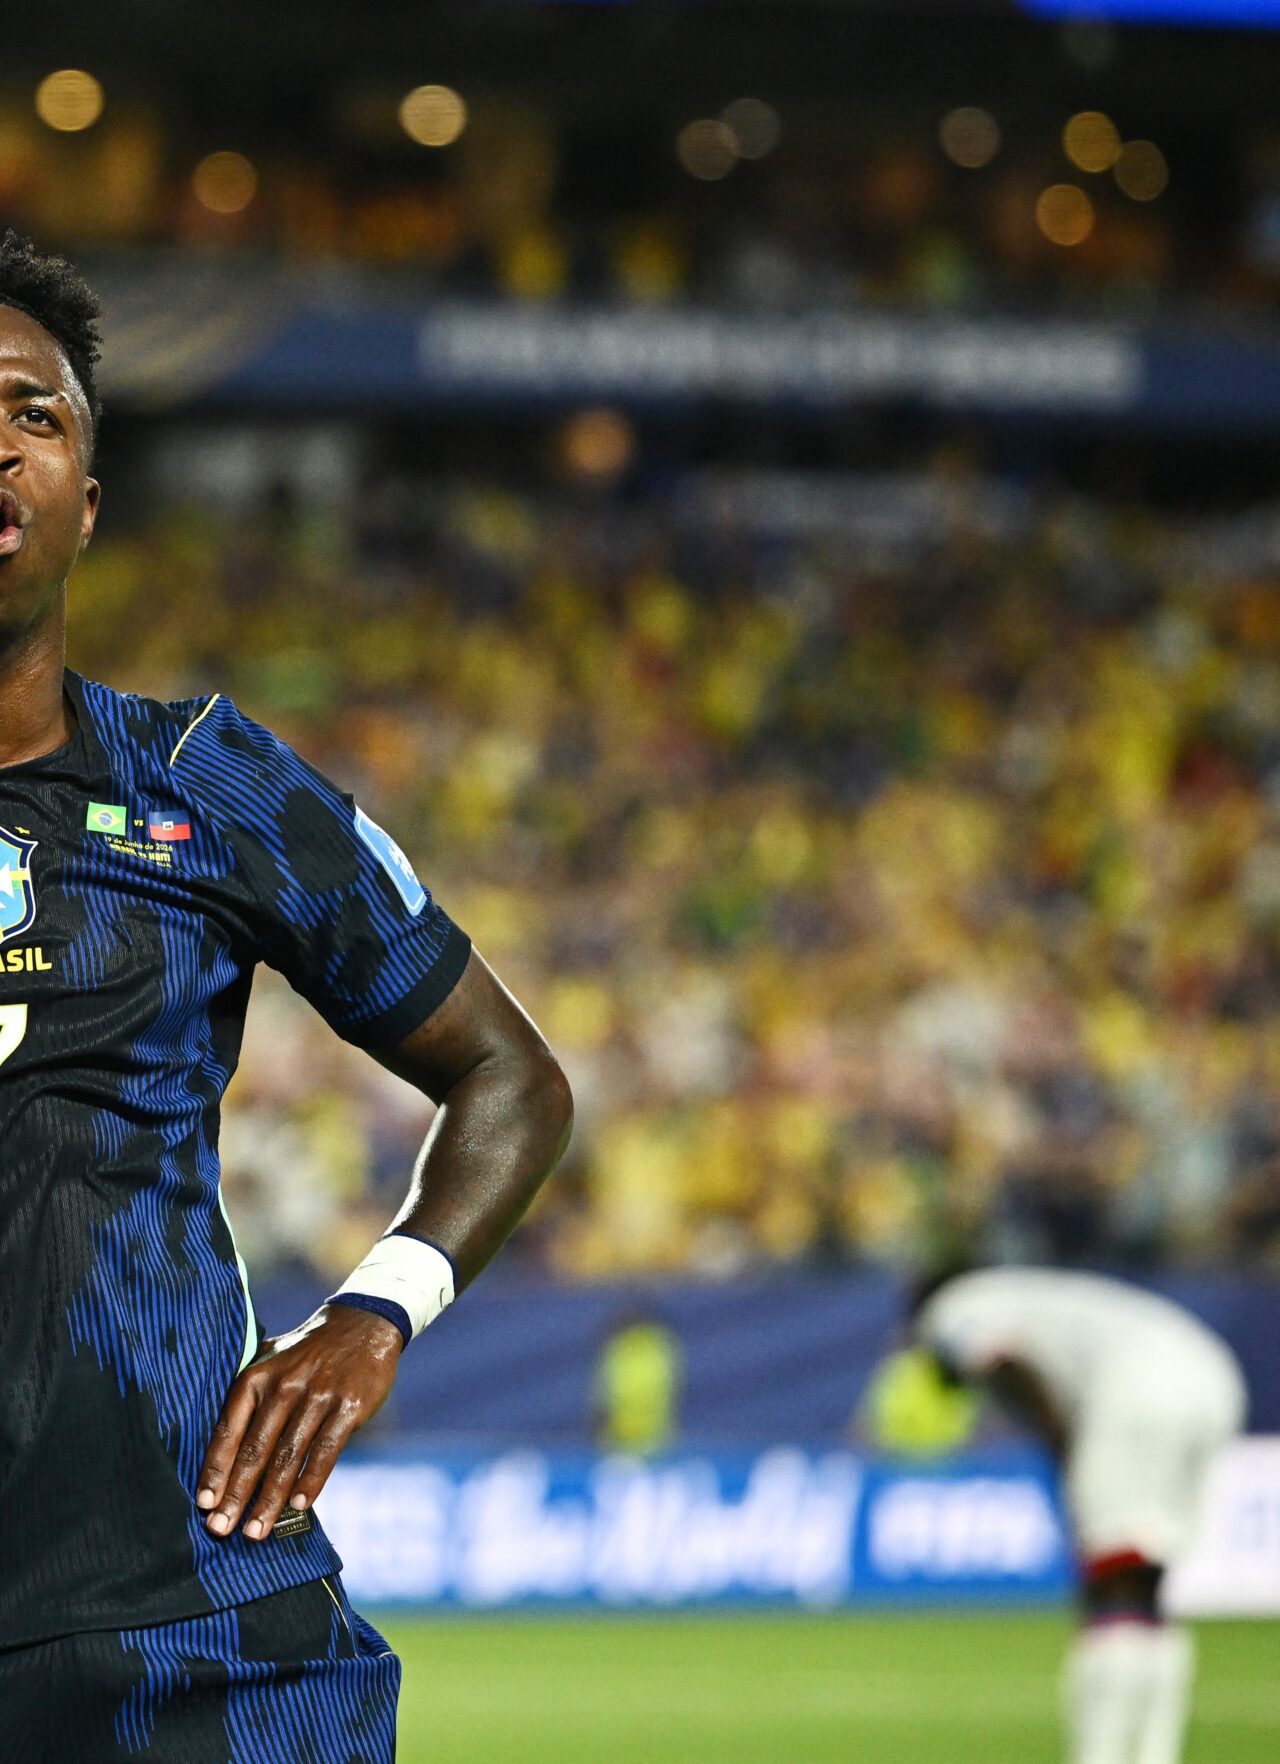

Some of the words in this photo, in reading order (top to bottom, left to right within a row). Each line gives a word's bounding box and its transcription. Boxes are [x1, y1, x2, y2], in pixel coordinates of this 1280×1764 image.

[133, 819, 144, 827] vs
[124, 840, 143, 849] Junho
[144, 842, 154, 850] de
[156, 843, 173, 852] 2026
